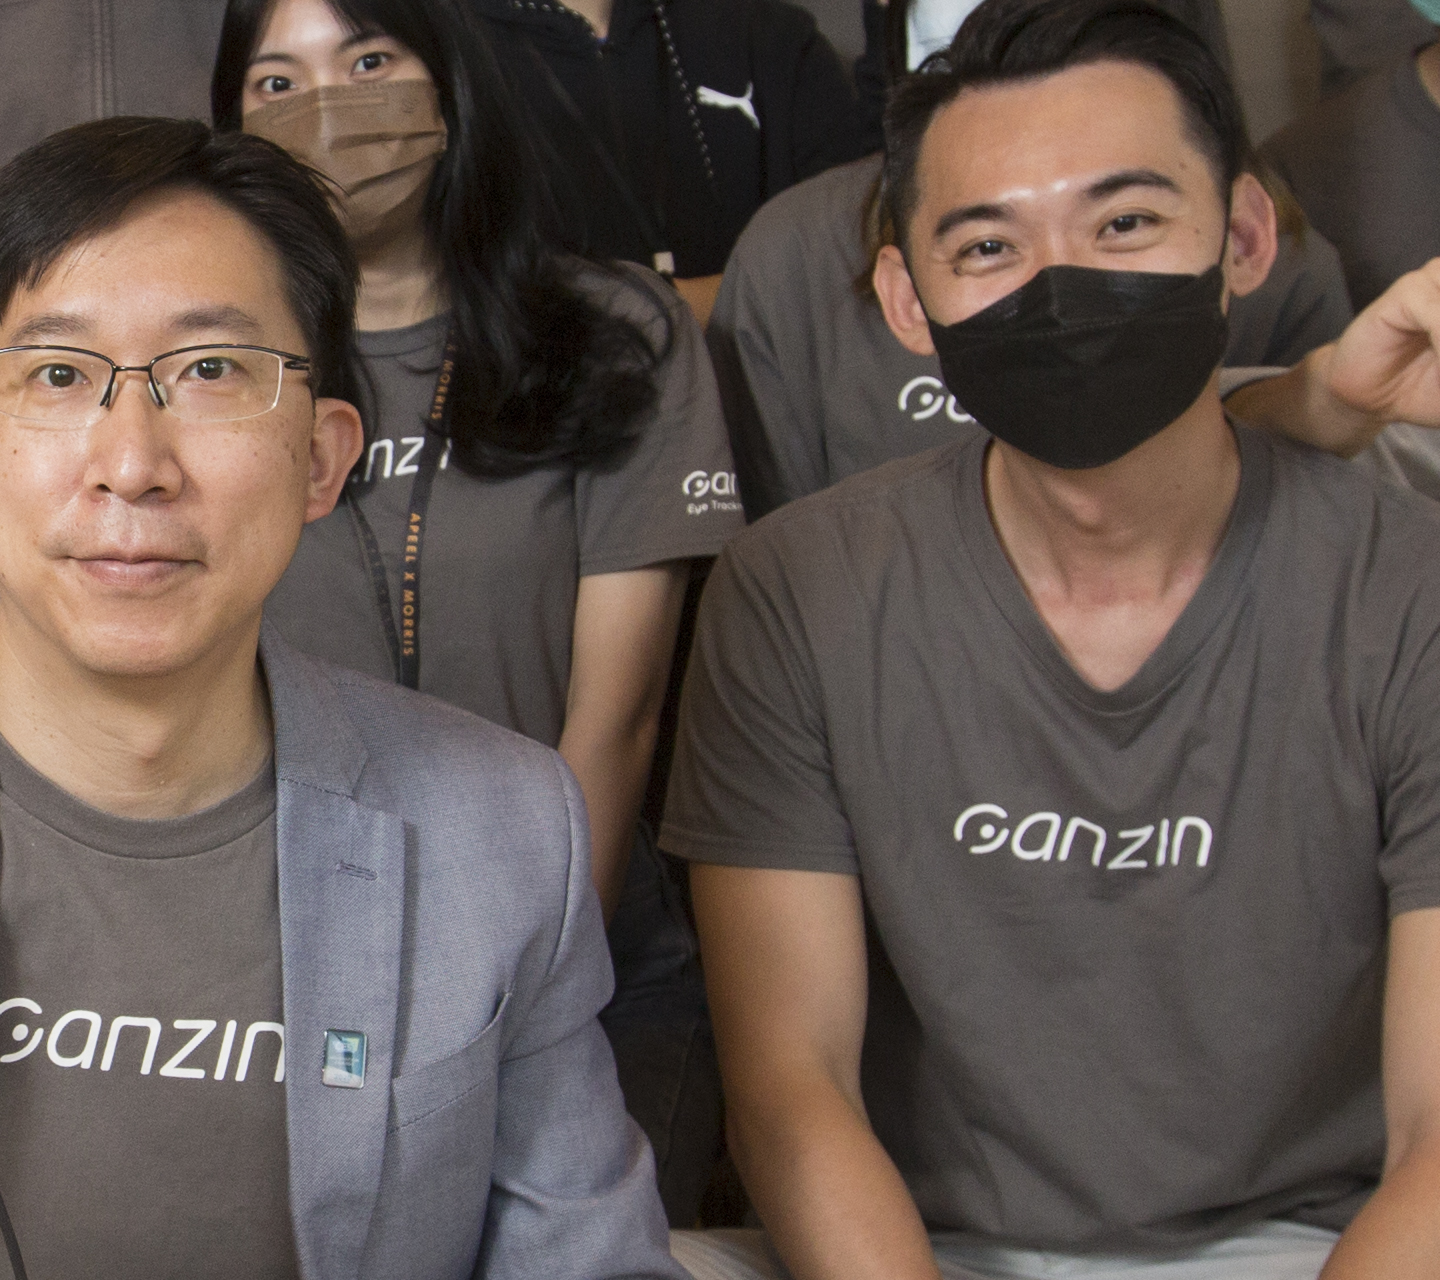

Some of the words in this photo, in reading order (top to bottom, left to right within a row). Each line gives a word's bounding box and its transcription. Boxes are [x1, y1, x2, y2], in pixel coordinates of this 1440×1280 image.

[430, 359, 455, 421] MORRIS
[687, 502, 709, 515] Eye
[404, 513, 421, 564] APEEL
[404, 572, 415, 581] X
[402, 589, 415, 657] MORRIS
[953, 800, 1213, 872] Ganzin
